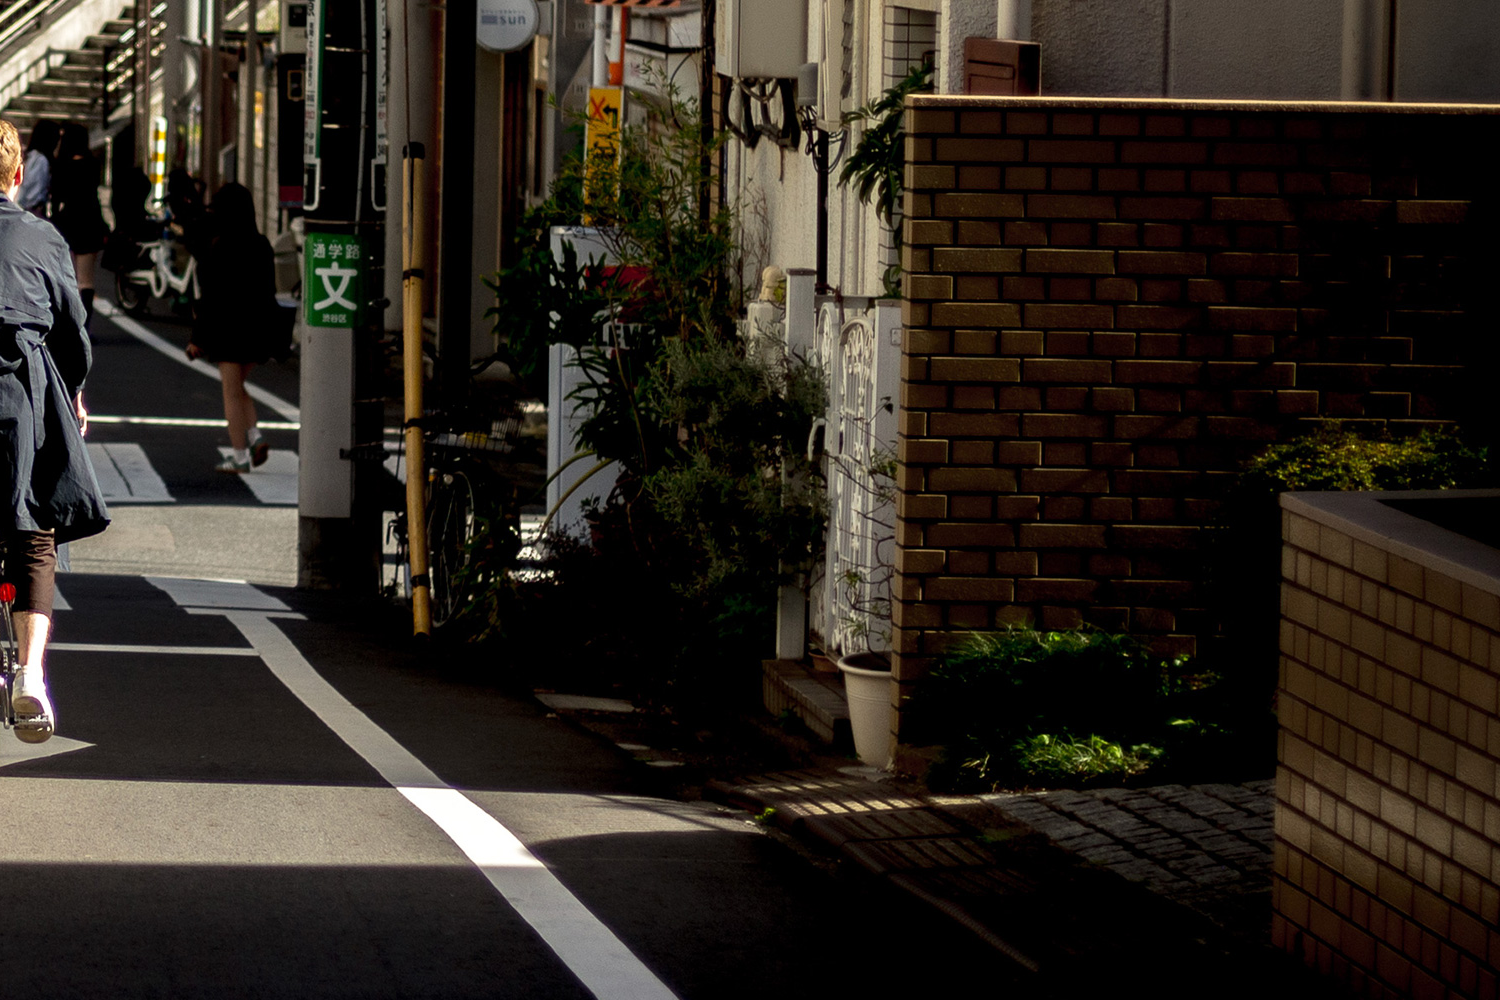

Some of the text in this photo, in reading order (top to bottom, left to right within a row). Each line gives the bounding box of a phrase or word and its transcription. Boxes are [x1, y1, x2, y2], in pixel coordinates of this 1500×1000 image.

[312, 243, 361, 260] 通学路
[313, 261, 358, 311] 文
